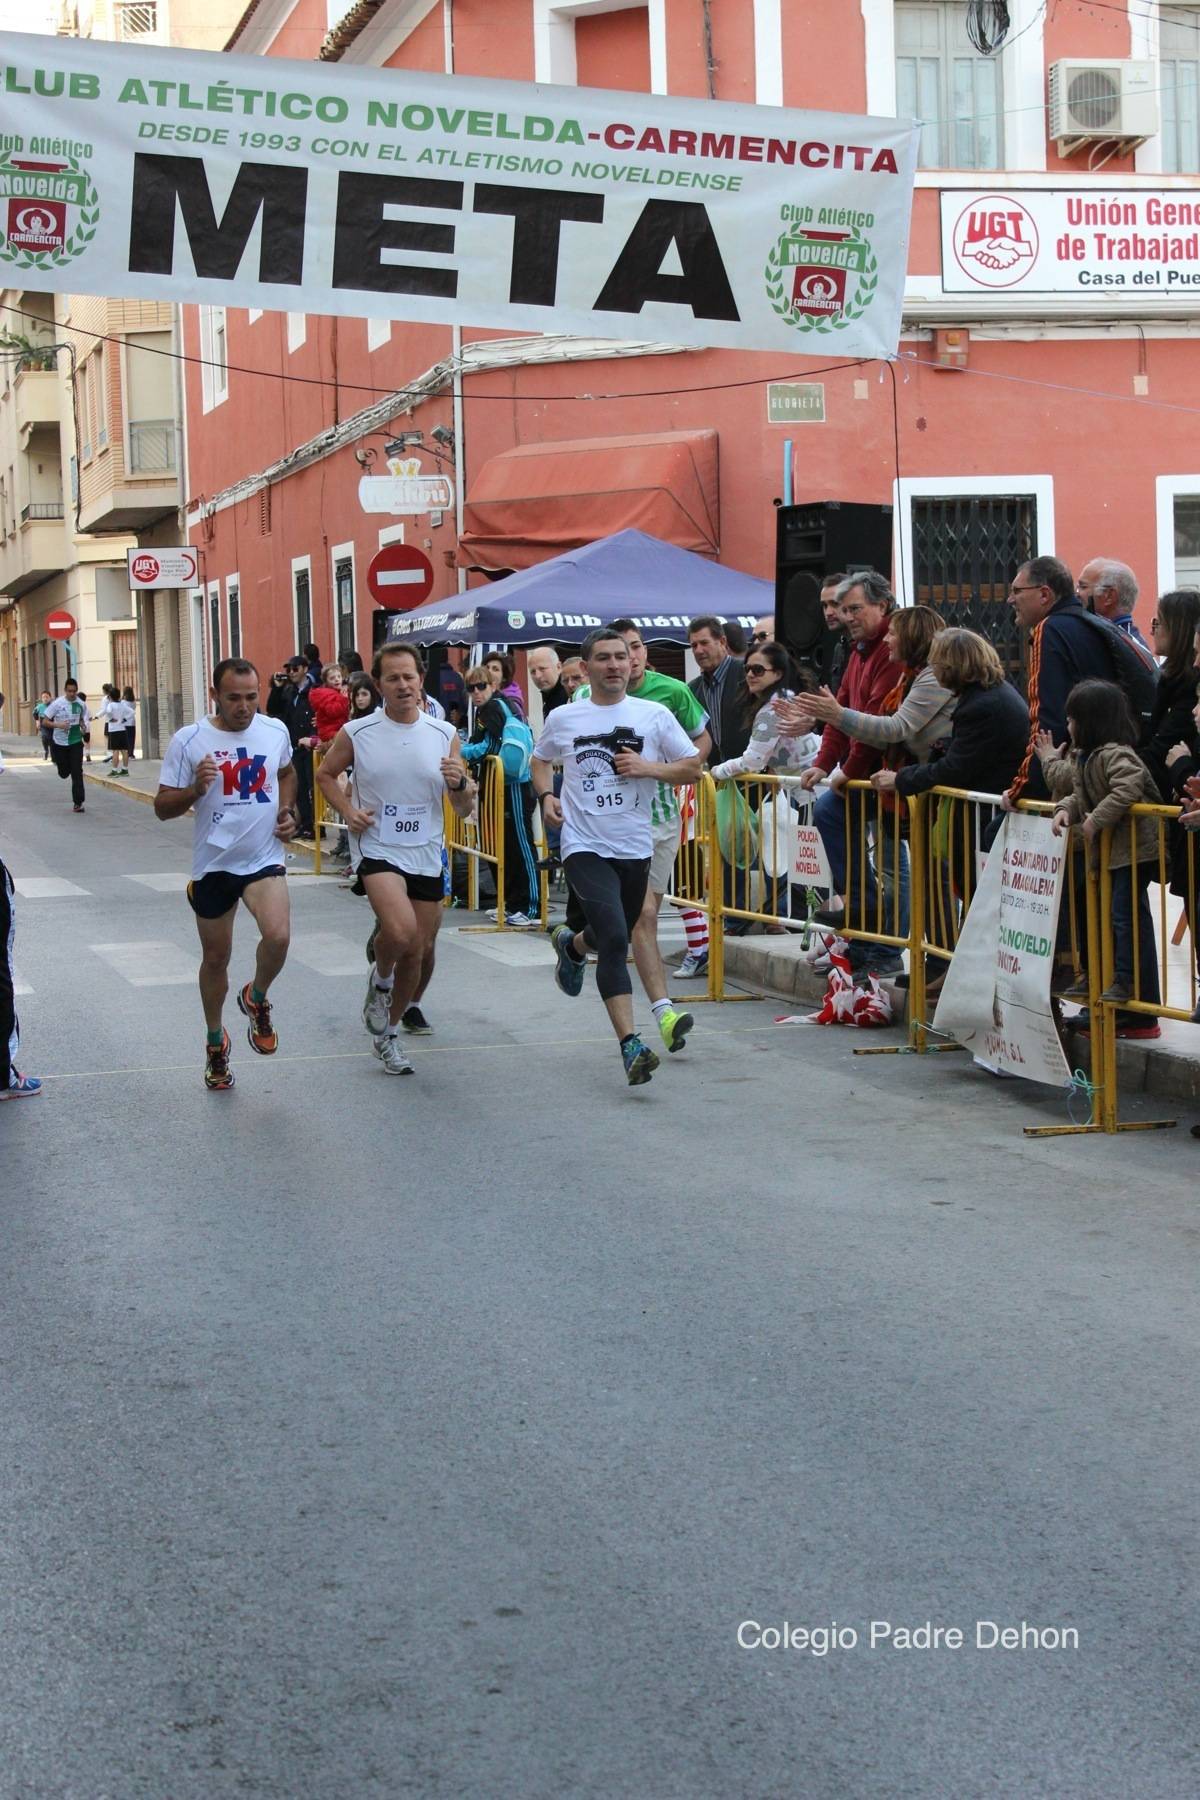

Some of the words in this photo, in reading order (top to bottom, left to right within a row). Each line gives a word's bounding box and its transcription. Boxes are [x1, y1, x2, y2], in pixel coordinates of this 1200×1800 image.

[0, 66, 101, 100] LUB
[117, 80, 349, 123] ATLÉTICO
[29, 136, 93, 159] Atlético
[138, 121, 230, 145] DESDE
[239, 131, 302, 151] 1993
[311, 137, 369, 157] CON
[377, 144, 408, 161] EL
[416, 148, 563, 175] ATLETISMO
[571, 161, 743, 192] NOVELDENSE
[0, 174, 79, 202] Novelda
[780, 203, 813, 223] Club
[818, 207, 875, 228] Atlético
[1066, 196, 1137, 226] Unión
[9, 232, 62, 245] CARMENCITA
[128, 151, 742, 322] META
[967, 211, 1024, 242] UGT
[788, 243, 859, 269] Novelda
[1056, 233, 1086, 261] de
[1077, 270, 1126, 286] Casa
[1132, 270, 1161, 286] del
[793, 298, 841, 310] CARMENCITA
[534, 611, 602, 628] Club
[596, 792, 623, 808] 915
[395, 820, 419, 833] 908
[799, 847, 817, 859] LOCAL
[795, 861, 821, 875] NOVELDA
